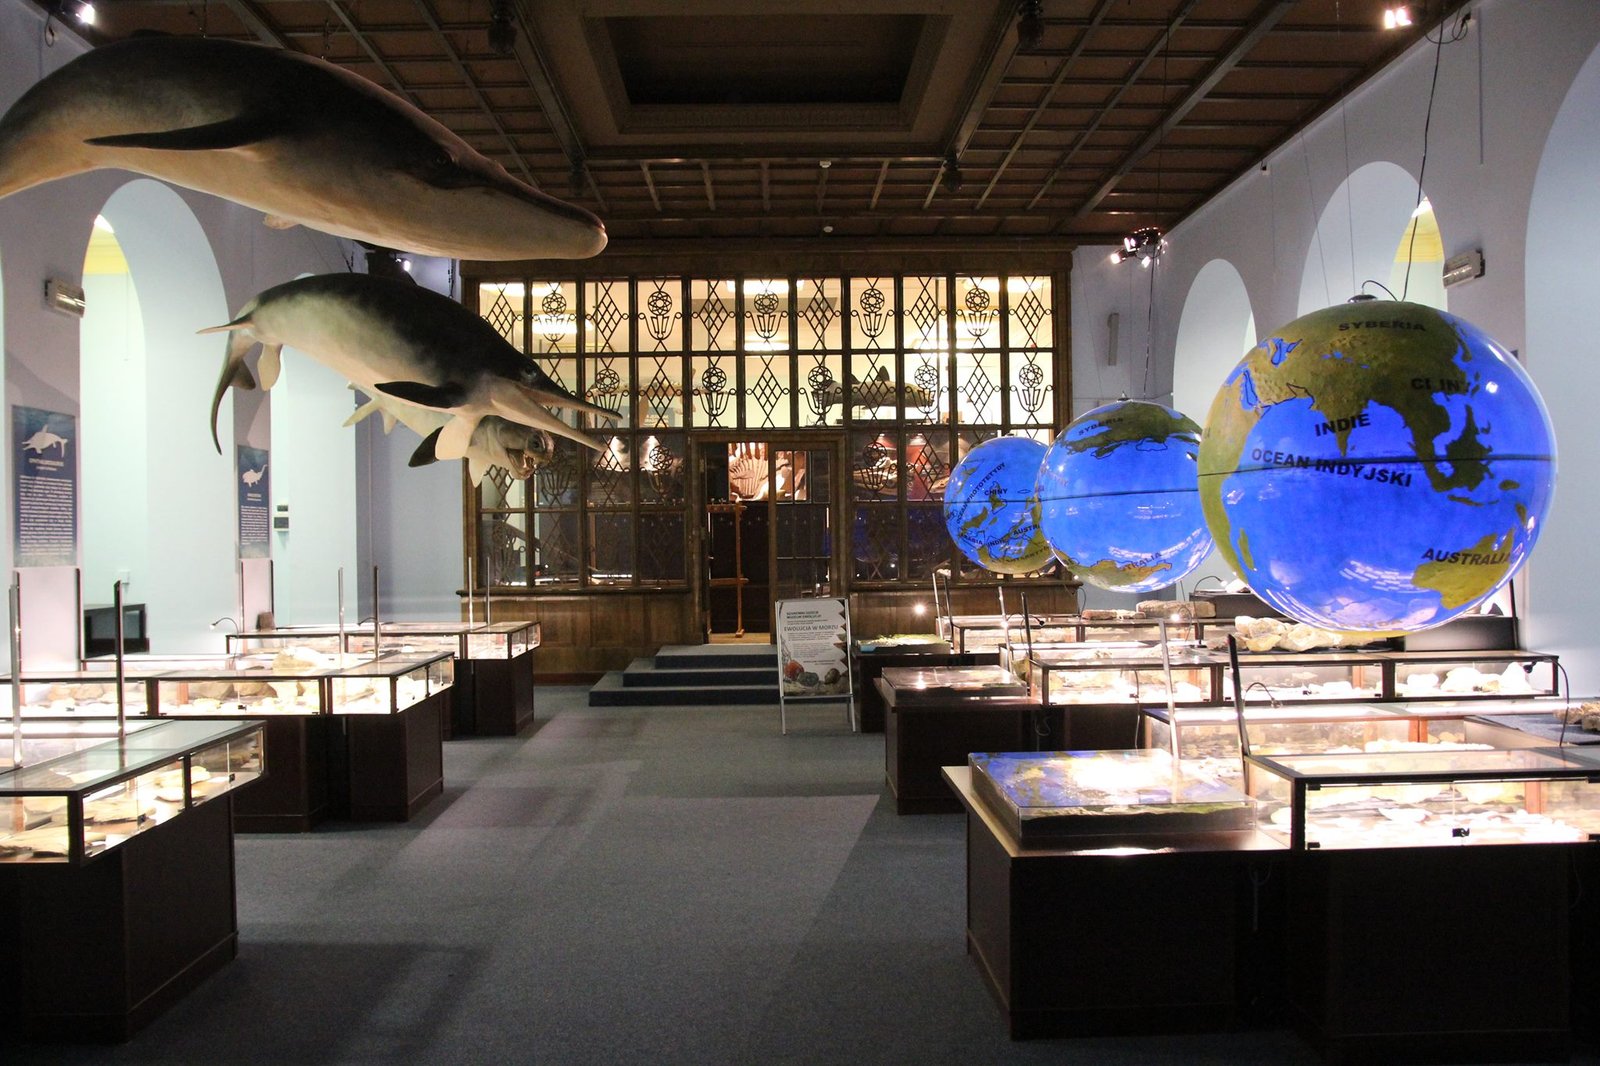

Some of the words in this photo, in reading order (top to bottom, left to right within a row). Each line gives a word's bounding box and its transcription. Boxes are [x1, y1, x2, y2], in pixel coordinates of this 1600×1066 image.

[1338, 320, 1426, 331] SYBERIA
[1314, 413, 1371, 437] INDIE
[1251, 448, 1310, 469] OCEAN
[1314, 459, 1412, 487] INDYJSKI
